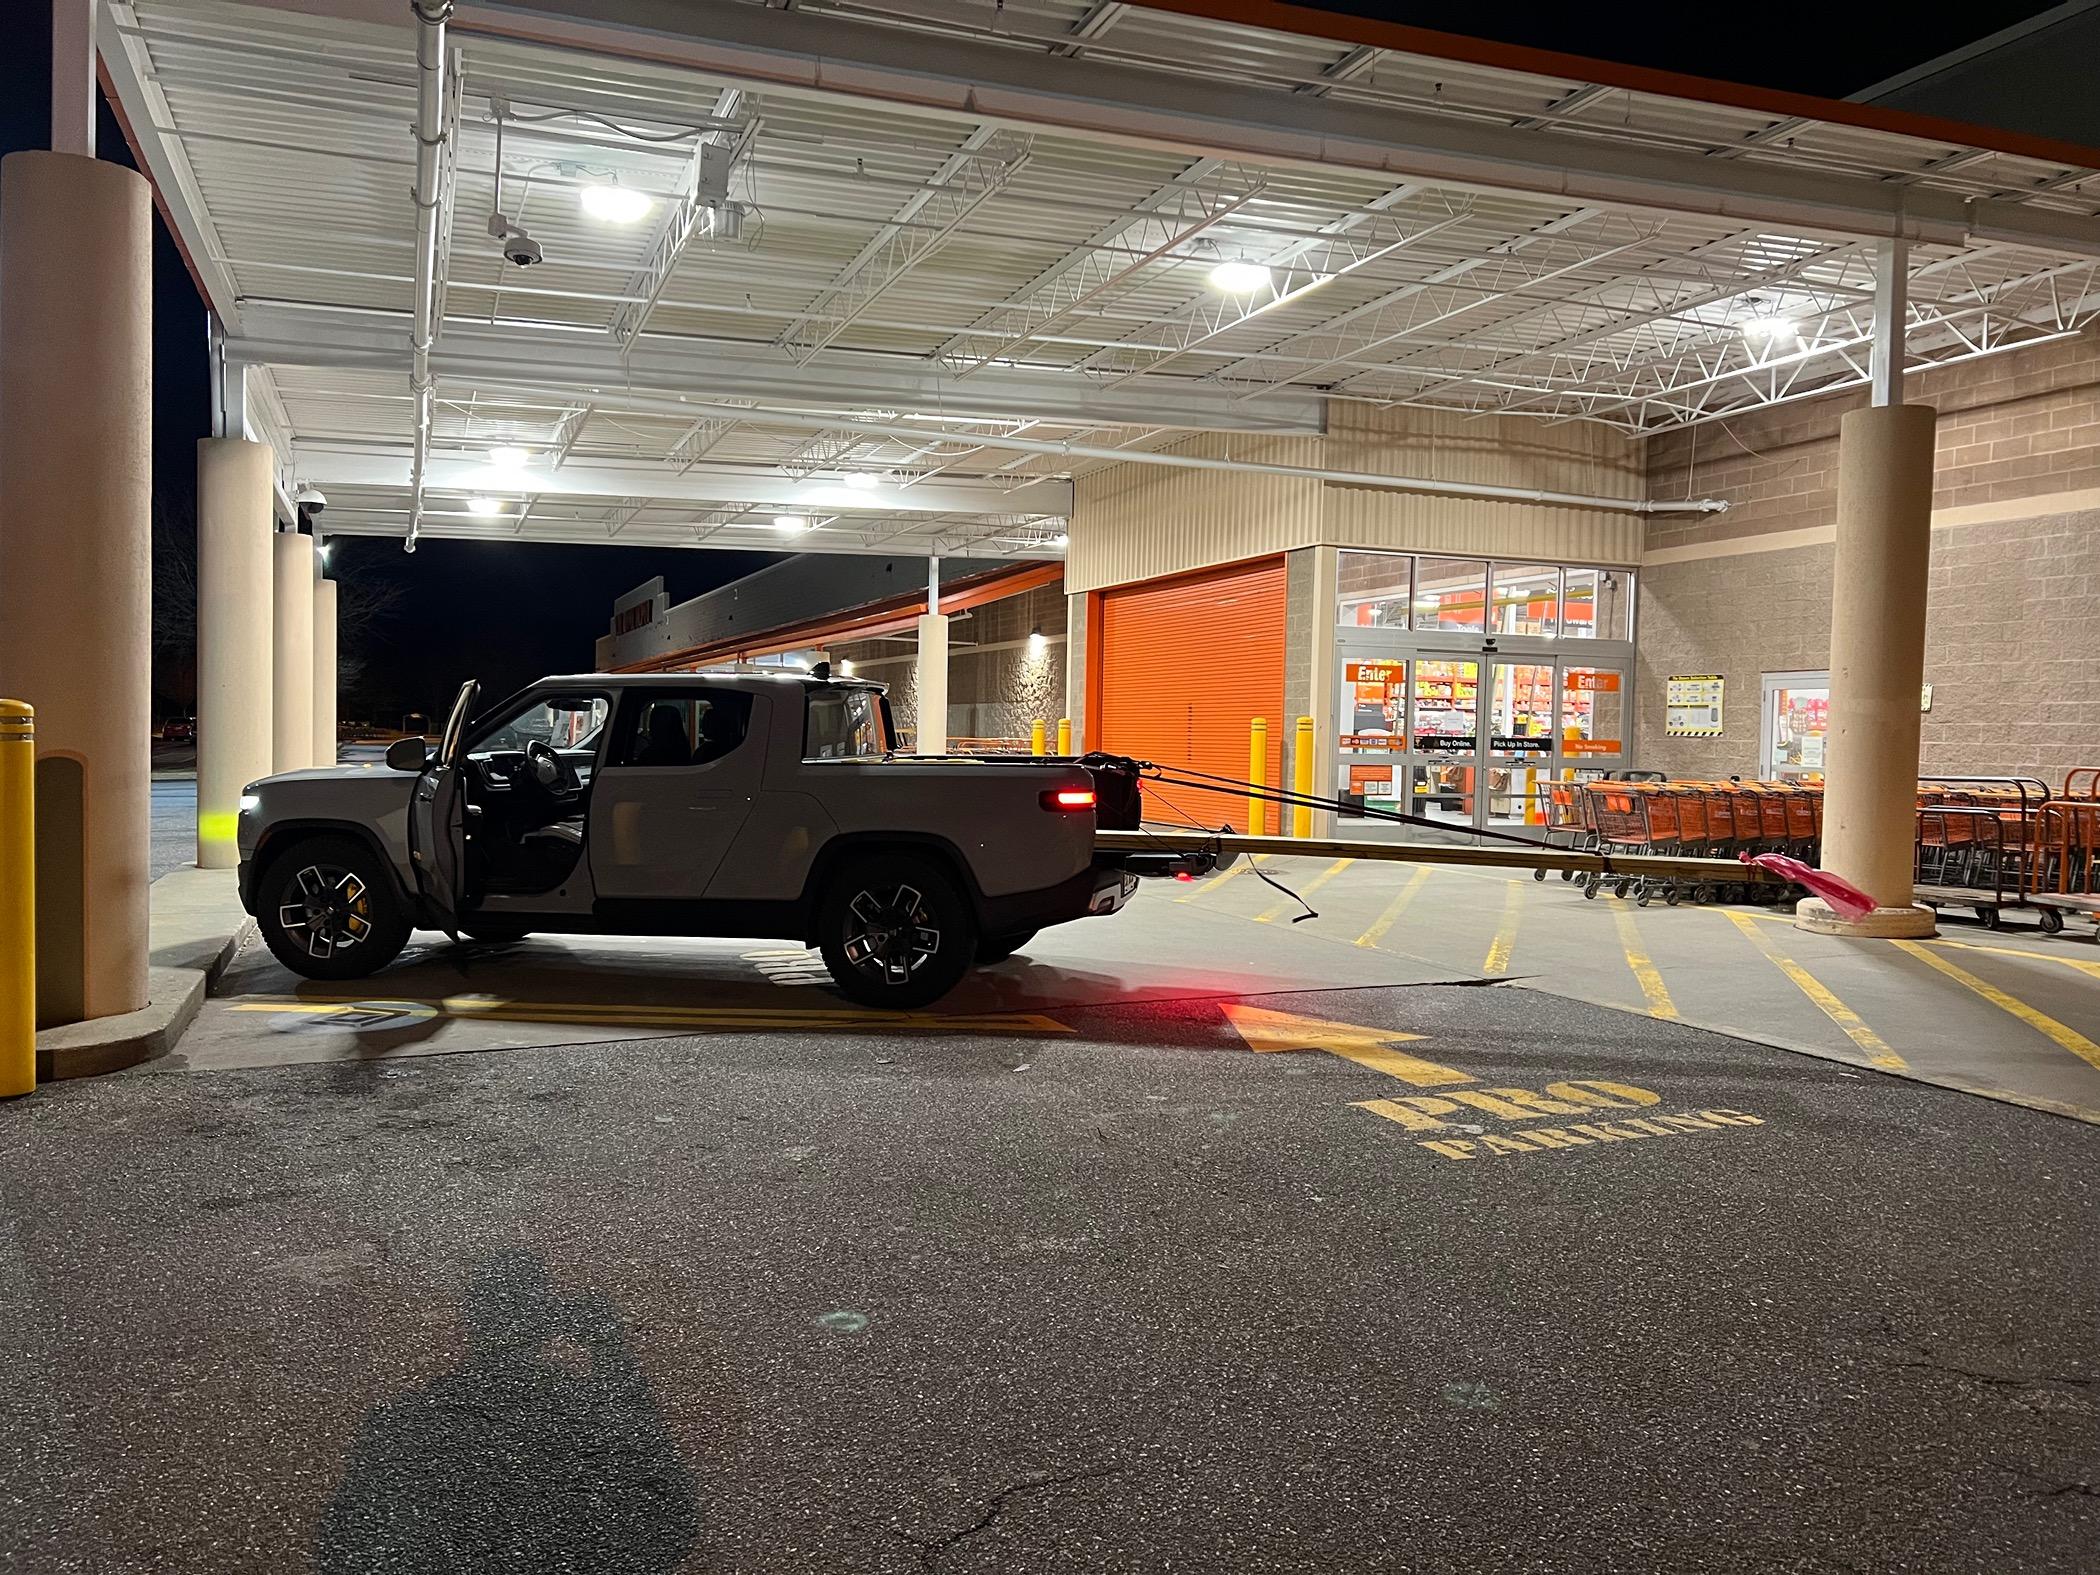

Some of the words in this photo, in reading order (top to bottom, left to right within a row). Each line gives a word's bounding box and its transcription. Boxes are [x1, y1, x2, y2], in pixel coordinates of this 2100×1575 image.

[1358, 666, 1392, 681] Enter
[1578, 675, 1608, 689] Enter
[1439, 739, 1451, 748] Buy
[1452, 739, 1472, 747] Online.
[1493, 740, 1506, 748] Pick
[1584, 743, 1607, 752] Smoking
[1346, 1080, 1661, 1131] PRO
[1418, 1109, 1766, 1160] PARKING
